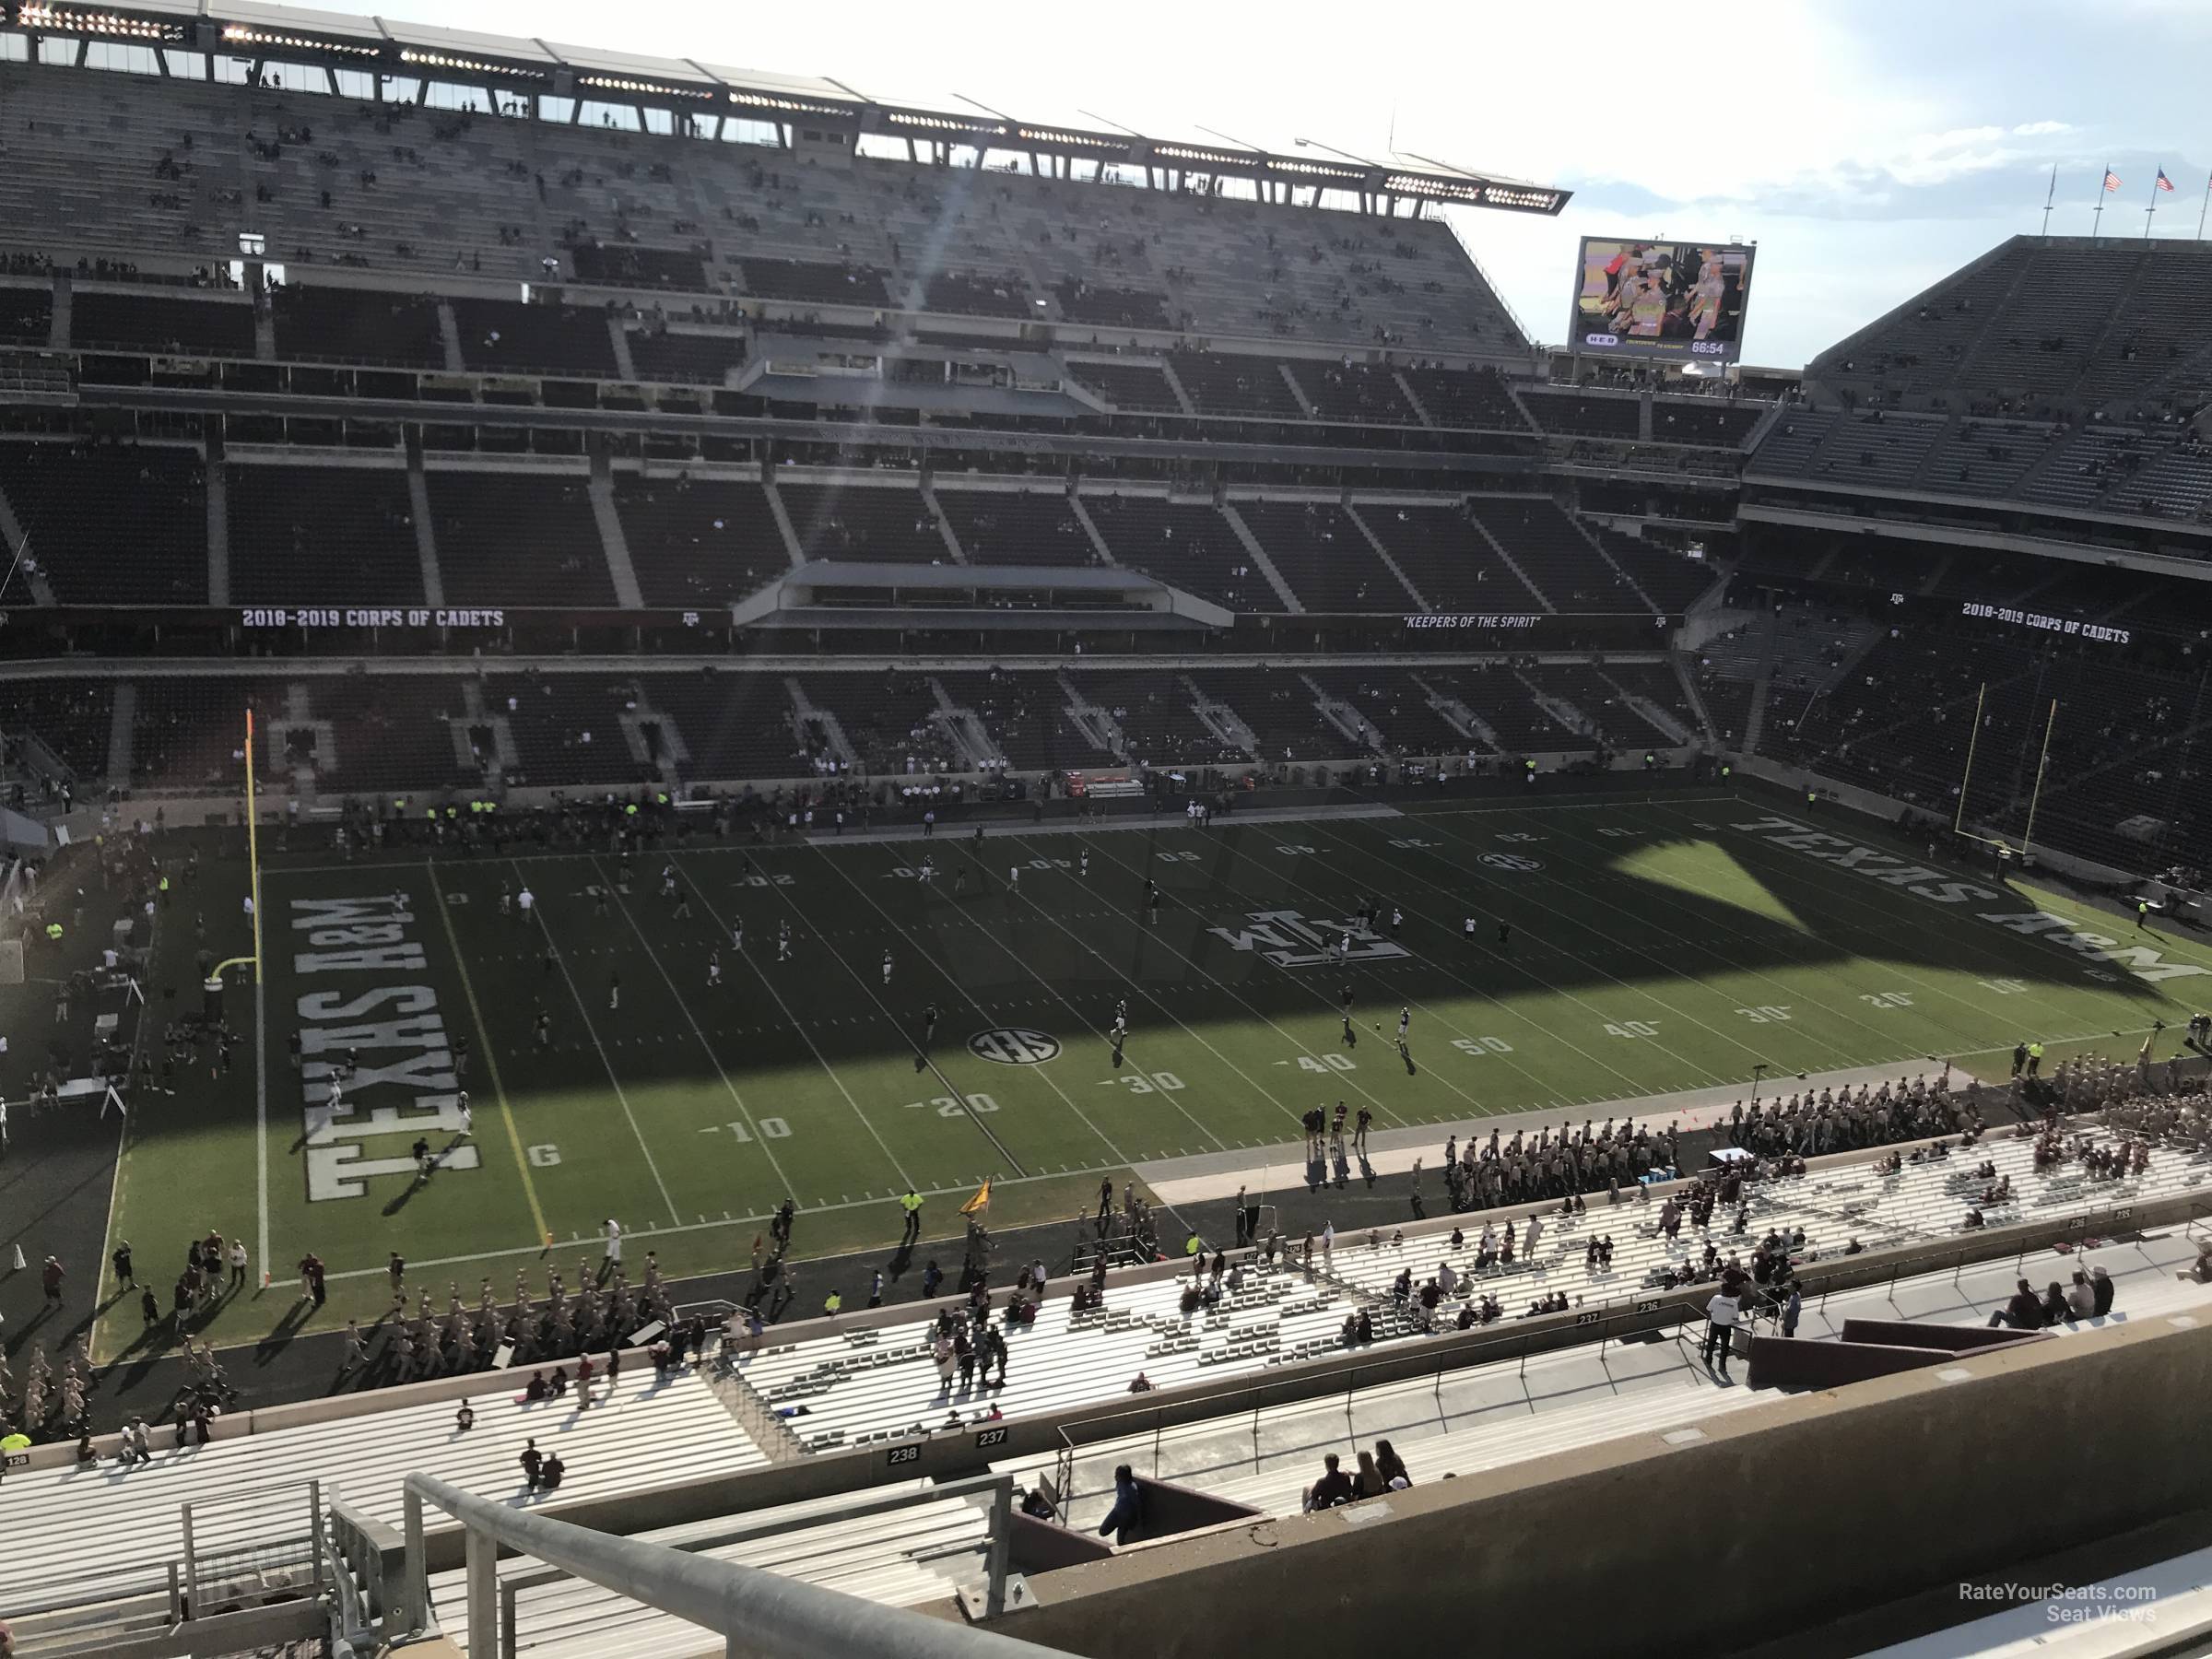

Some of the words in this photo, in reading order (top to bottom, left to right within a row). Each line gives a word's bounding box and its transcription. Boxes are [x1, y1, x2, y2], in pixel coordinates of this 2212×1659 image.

[1692, 342, 1724, 355] 66:54
[242, 609, 339, 626] 2018-2019
[347, 609, 403, 626] CORPS
[408, 609, 430, 626] OF
[436, 610, 504, 626] CADETS
[1460, 616, 1475, 628] OF
[1477, 616, 1497, 628] THE
[1962, 603, 2024, 624] 2018-2019
[2026, 613, 2063, 631] CORPS
[2065, 620, 2080, 634] OF
[2082, 624, 2131, 644] CADETS
[1156, 851, 1202, 862] 50
[1729, 817, 1999, 903] TEXAS
[1977, 912, 2212, 982] A&M
[290, 893, 427, 974] A&M
[1859, 993, 1912, 1009] 20
[1735, 1006, 1790, 1024] 30
[1603, 1021, 1655, 1039] 40
[974, 1030, 1055, 1063] SEC
[1451, 1036, 1513, 1056] 50
[1297, 1053, 1358, 1074] 40
[1119, 1072, 1186, 1095] 30
[298, 985, 480, 1203] TEXAS
[931, 1093, 1000, 1118] 20
[726, 1117, 793, 1143] 10
[527, 1144, 561, 1168] G
[1640, 1301, 1658, 1312] 236
[979, 1430, 1005, 1445] 237
[7, 1455, 27, 1466] 128
[890, 1447, 917, 1464] 238
